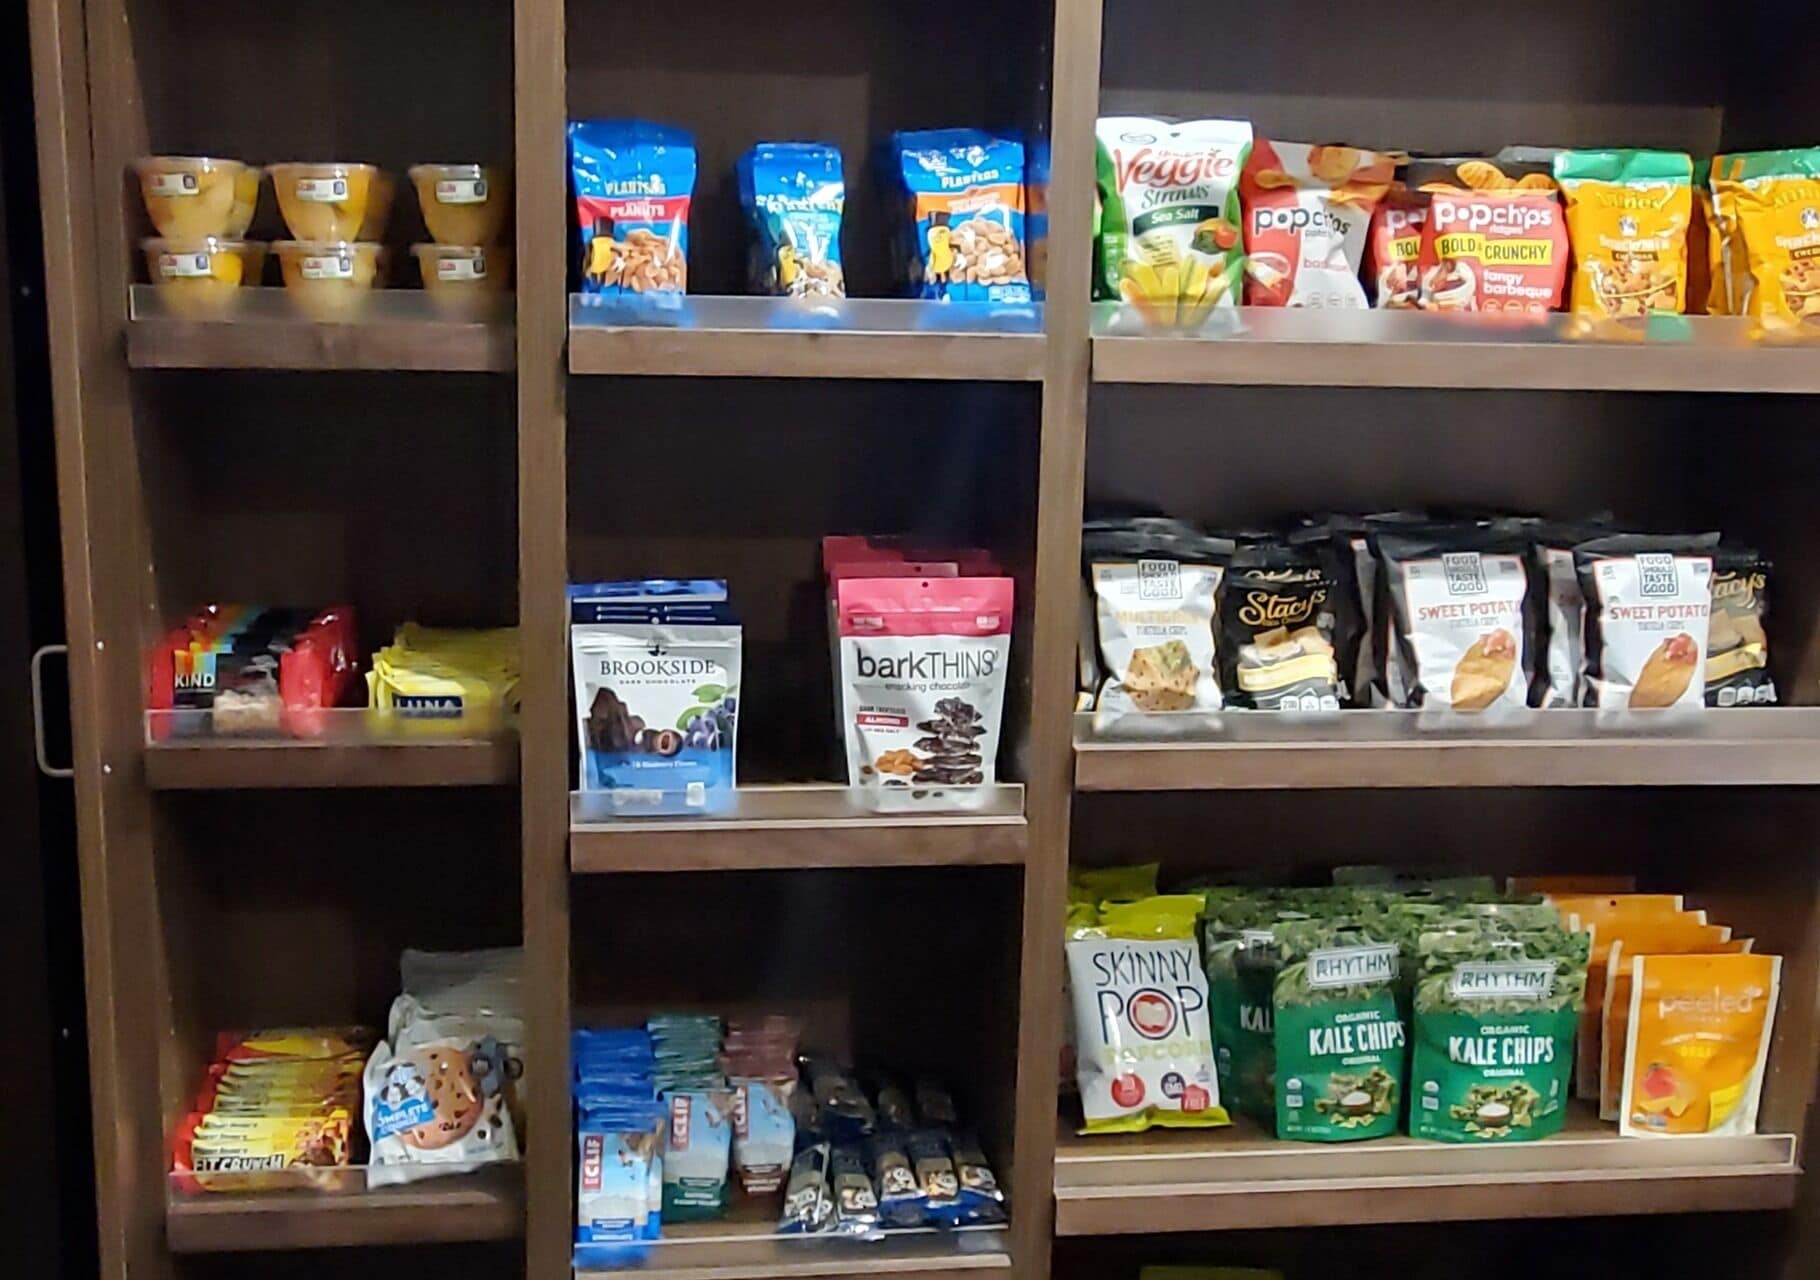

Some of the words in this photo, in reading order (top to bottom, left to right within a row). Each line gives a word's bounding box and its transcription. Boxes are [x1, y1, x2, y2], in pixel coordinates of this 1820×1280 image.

[1113, 148, 1233, 193] Veggie
[1152, 211, 1173, 224] Sea
[1175, 208, 1199, 220] Salt
[1434, 203, 1552, 231] popchips
[1441, 238, 1476, 255] BOLD
[1485, 245, 1547, 260] CRUNCHY
[1483, 270, 1524, 287] tangy
[1483, 283, 1552, 298] barbeque
[1446, 555, 1477, 565] FOOD
[1449, 573, 1479, 581] TASTE
[1644, 574, 1674, 582] TASTE
[1643, 583, 1675, 593] GOOD
[1711, 571, 1767, 608] tacy's
[1239, 590, 1327, 625] Stacy's
[1418, 604, 1466, 620] SWEET
[1610, 606, 1655, 620] SWEET
[1657, 605, 1708, 618] POTATO
[600, 660, 716, 676] BROOKSIDE
[857, 648, 994, 679] barkTHINS
[175, 672, 215, 688] KIND
[396, 699, 456, 711] LUNA
[1093, 945, 1192, 986] SKINNY
[1316, 954, 1392, 977] RHYTHM
[1460, 971, 1546, 988] RHYTHM
[1659, 985, 1755, 1019] peeled
[1097, 986, 1203, 1045] POP
[1240, 1006, 1272, 1032] KAL
[1335, 1010, 1381, 1023] ORGANIC
[1309, 1023, 1354, 1056] KALE
[1357, 1021, 1406, 1052] CHIPS
[1480, 1024, 1530, 1036] ORGANIC
[1449, 1037, 1497, 1065] KALE
[1502, 1037, 1554, 1065] CHIPS
